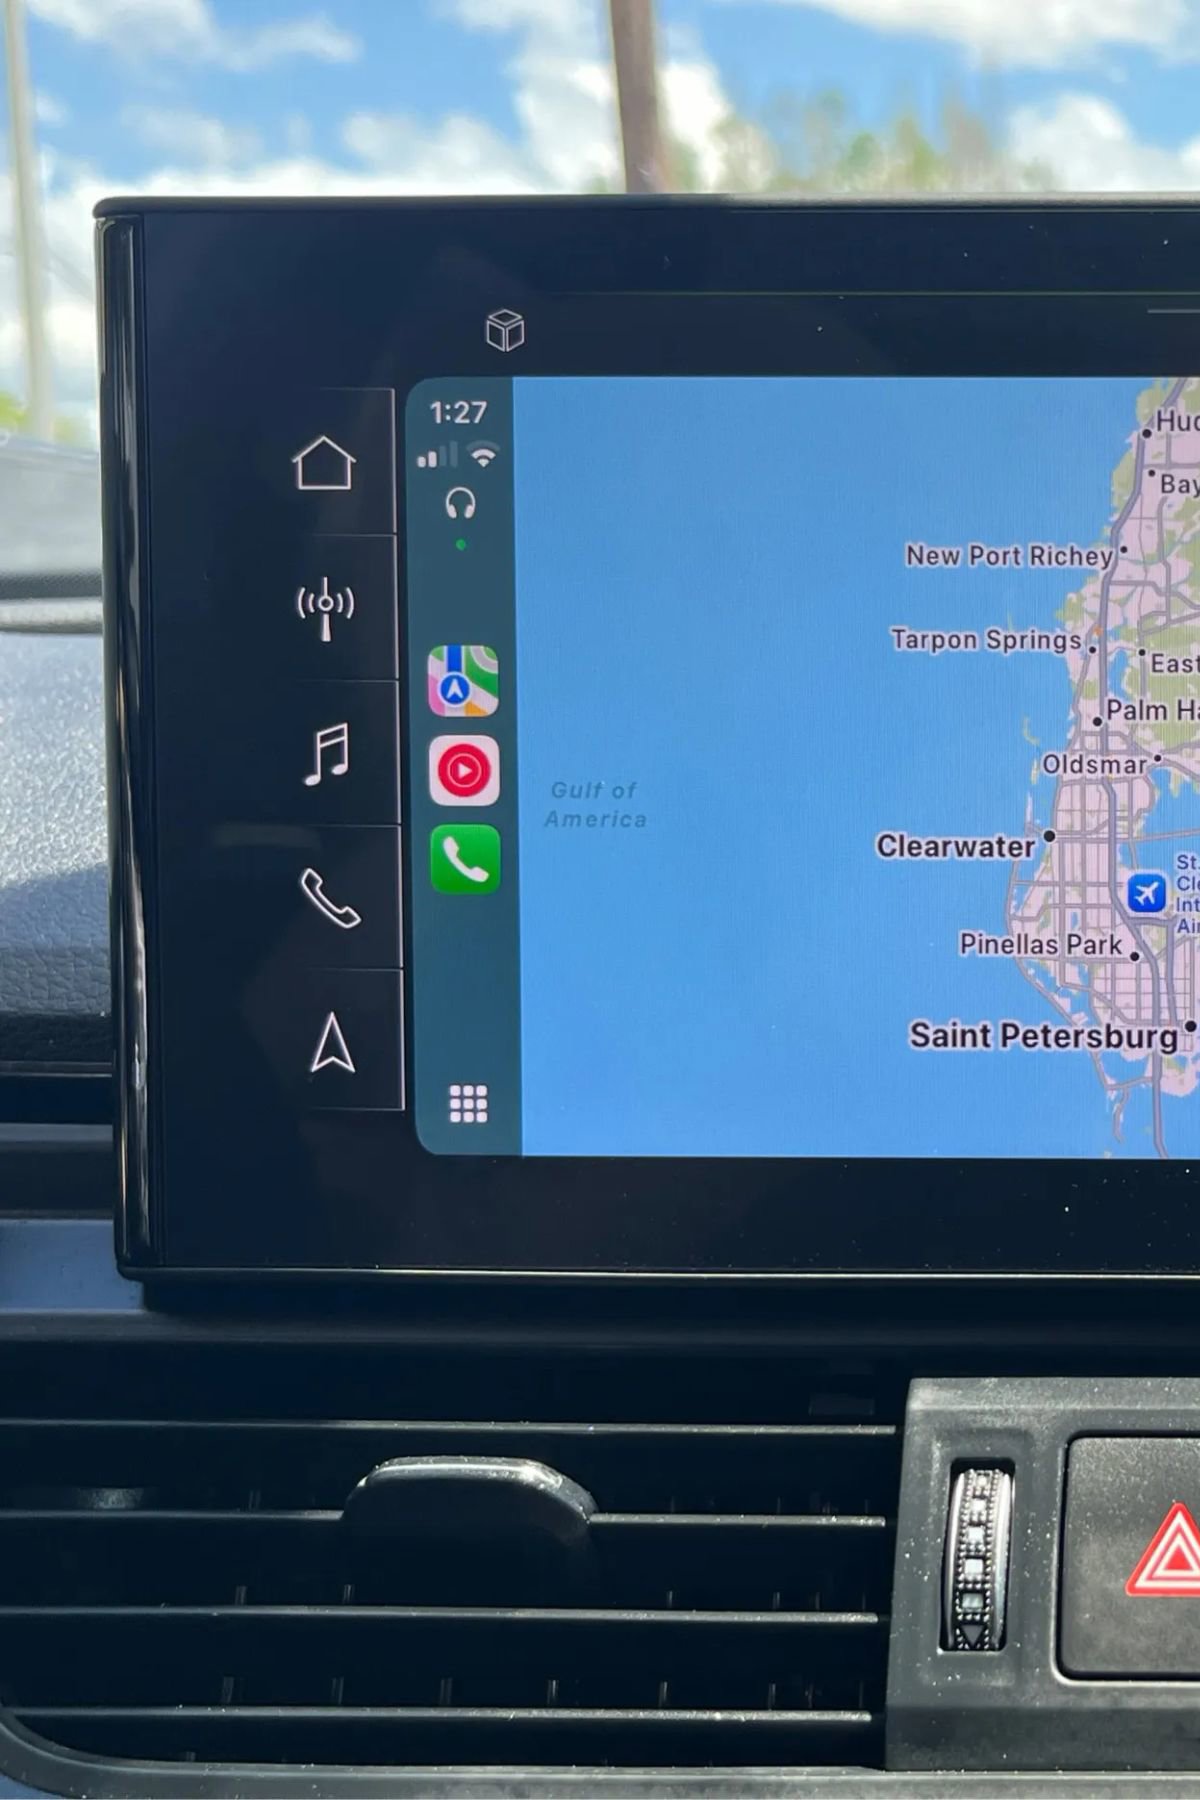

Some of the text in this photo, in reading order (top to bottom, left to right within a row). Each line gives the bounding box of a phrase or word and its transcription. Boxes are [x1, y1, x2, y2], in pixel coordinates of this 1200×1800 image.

[430, 401, 488, 424] 1:27
[907, 545, 1113, 569] New Port Richey
[893, 630, 1081, 653] Tarpon Springs
[1108, 699, 1167, 720] Palm
[1043, 754, 1148, 774] Oldsmar
[551, 781, 638, 799] Gulf of
[544, 810, 647, 828] America
[877, 834, 1035, 858] Clearwater
[961, 933, 1122, 955] Pinellas Park
[911, 1023, 1178, 1054] Saint Petersburg
